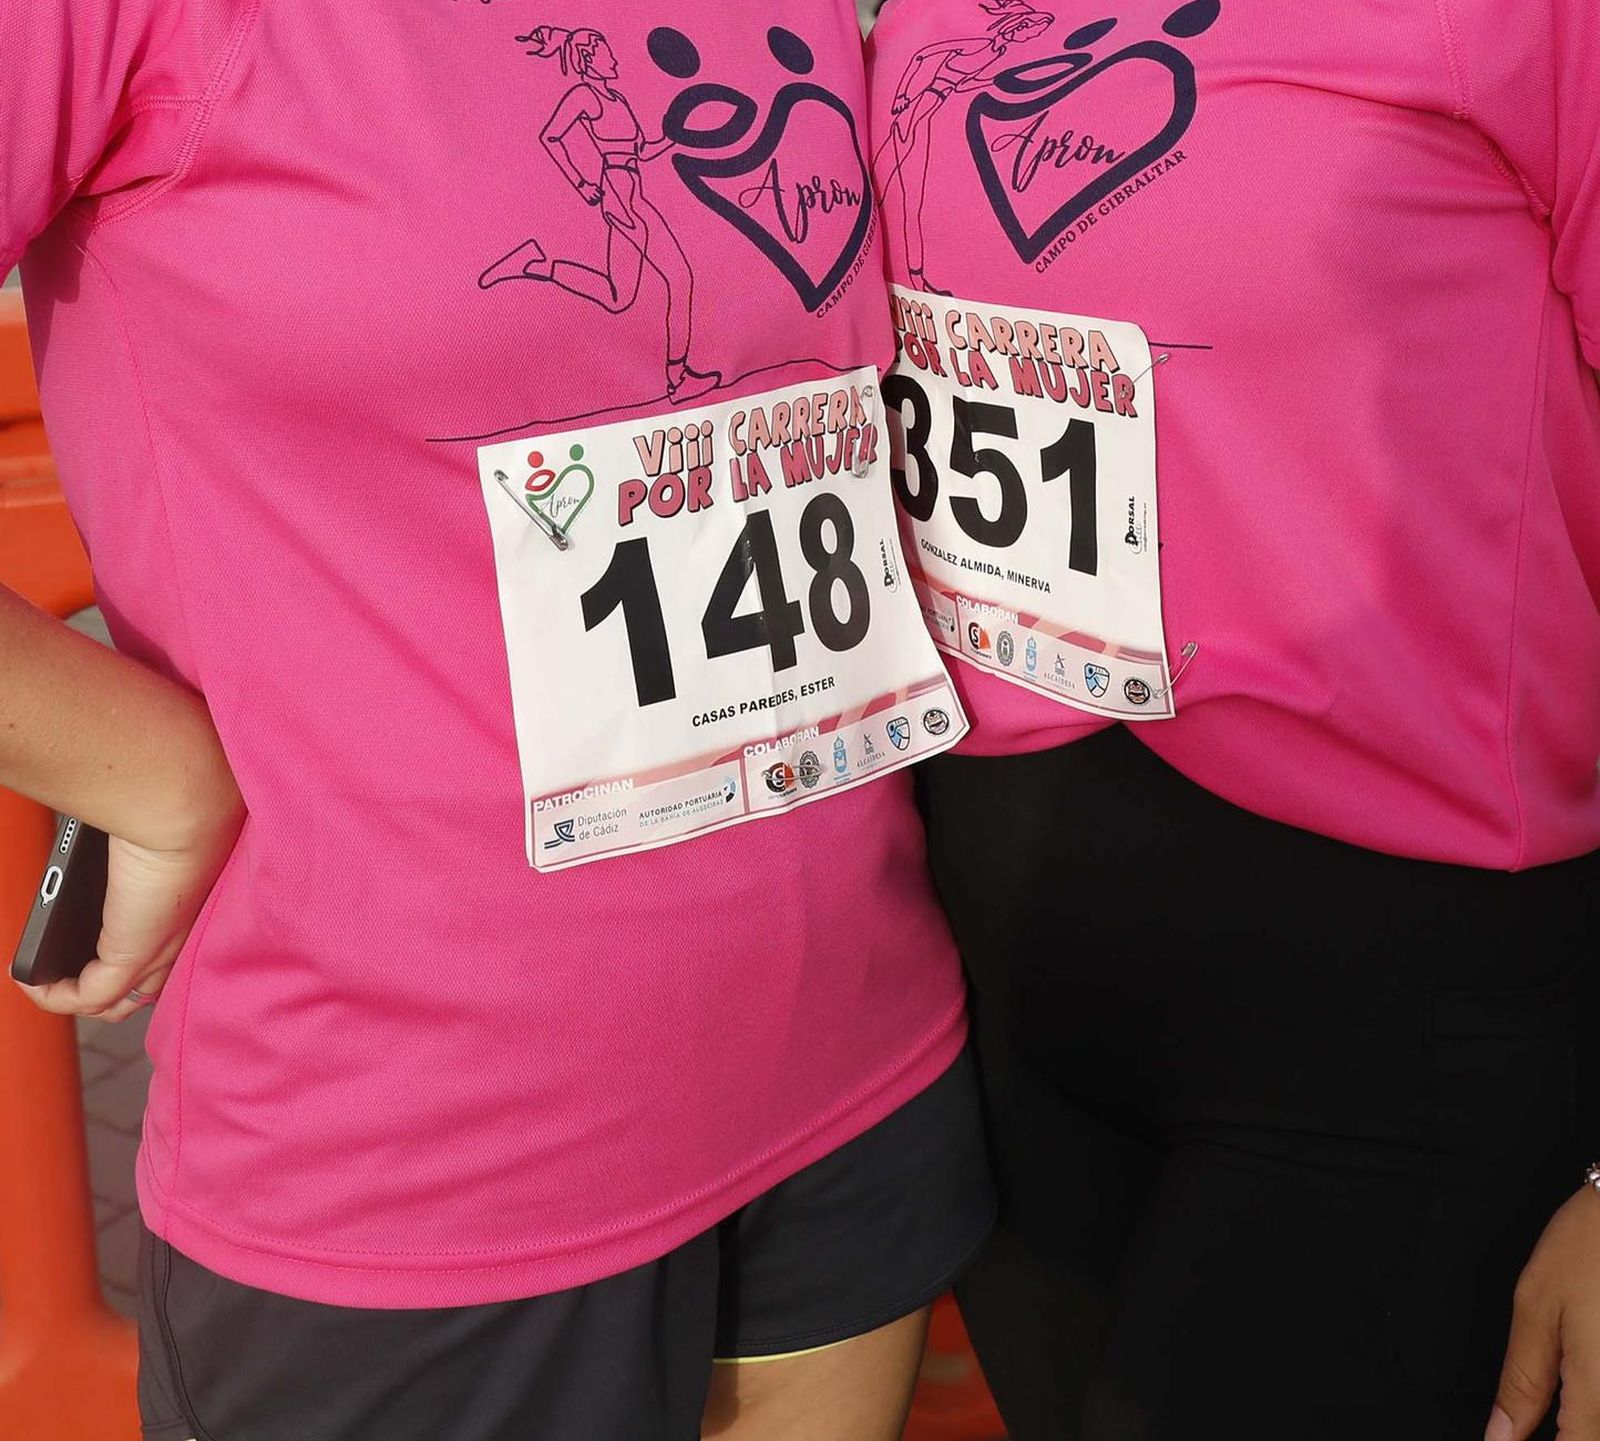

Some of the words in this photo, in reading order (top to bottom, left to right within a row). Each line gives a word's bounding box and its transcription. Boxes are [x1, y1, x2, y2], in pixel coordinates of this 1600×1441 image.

[991, 110, 1126, 193] Apron
[738, 157, 861, 244] Apron
[1035, 229, 1077, 274] CAMPO
[1076, 211, 1098, 235] DE
[1098, 149, 1188, 216] GIBRALTAR
[816, 274, 854, 319] CAMPO
[852, 254, 865, 276] DE
[944, 309, 1121, 373] CARRERA
[895, 331, 949, 378] OR
[949, 347, 999, 391] LA
[1008, 356, 1139, 418] MUJER
[728, 385, 867, 456] CARRERA
[618, 464, 714, 527] POR
[729, 450, 773, 503] LA
[780, 423, 879, 489] MUJER
[881, 373, 1100, 577] 351
[920, 538, 958, 566] GONZALEZ
[960, 558, 1004, 580] ALMIDA,
[1006, 569, 1051, 594] MINERVA
[579, 492, 871, 708] 148
[955, 594, 1019, 624] COLABORAN
[692, 705, 736, 728] CASAS
[739, 689, 798, 715] PAREDES,
[800, 676, 836, 697] ESTER
[743, 726, 820, 758] COLABORAN
[533, 778, 636, 812] PATROCINAN
[577, 807, 628, 828] Diputación
[639, 802, 683, 820] AUTORIDAD
[685, 790, 723, 808] PORTUARIA
[578, 829, 591, 842] de
[593, 823, 620, 838] Cádiz
